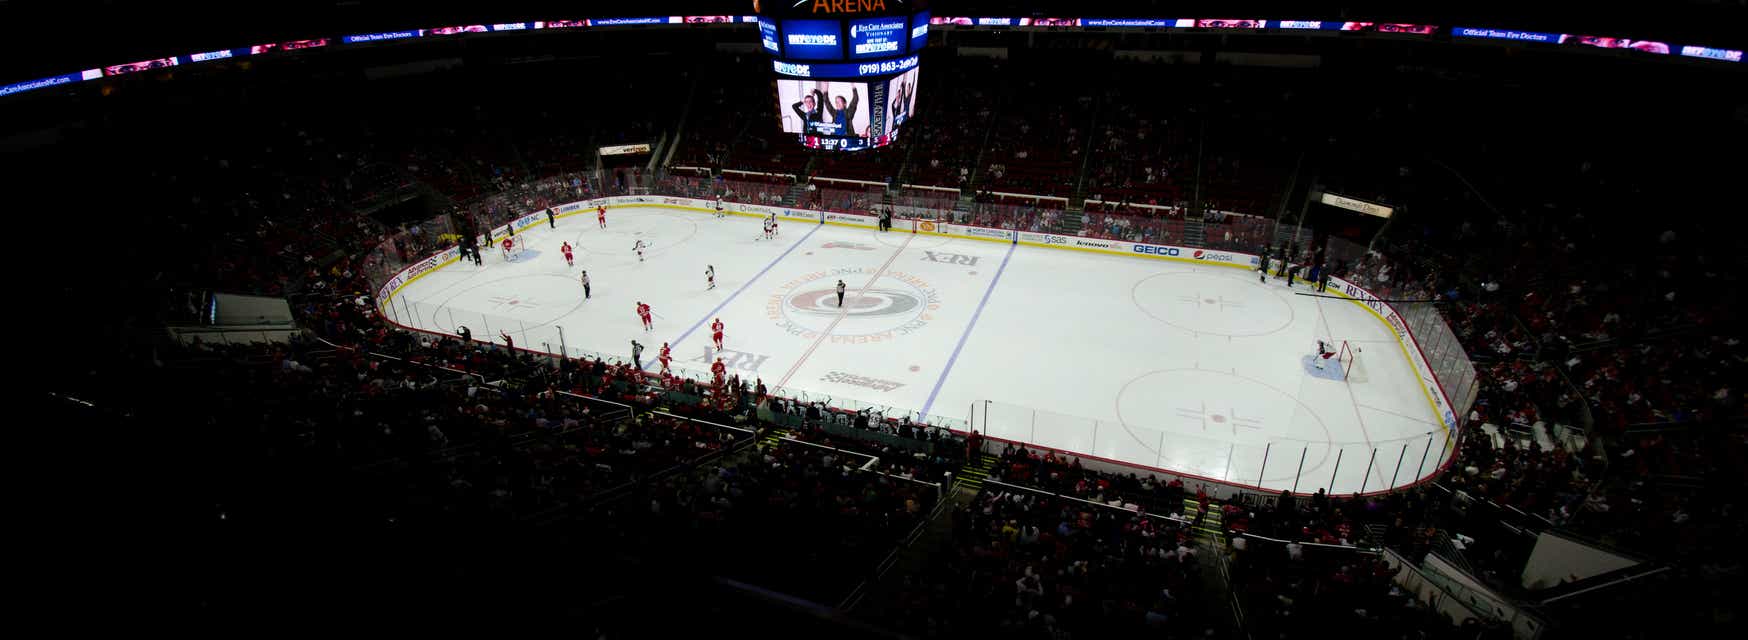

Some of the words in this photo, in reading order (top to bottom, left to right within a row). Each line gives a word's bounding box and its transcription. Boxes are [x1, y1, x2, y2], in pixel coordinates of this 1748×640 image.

[813, 0, 886, 13] ARENA
[858, 63, 880, 76] (919)
[1050, 235, 1067, 244] sas
[1076, 240, 1109, 249] lenovo
[1133, 244, 1180, 256] GEICO
[919, 251, 983, 266] REX
[1206, 253, 1233, 262] pepsi
